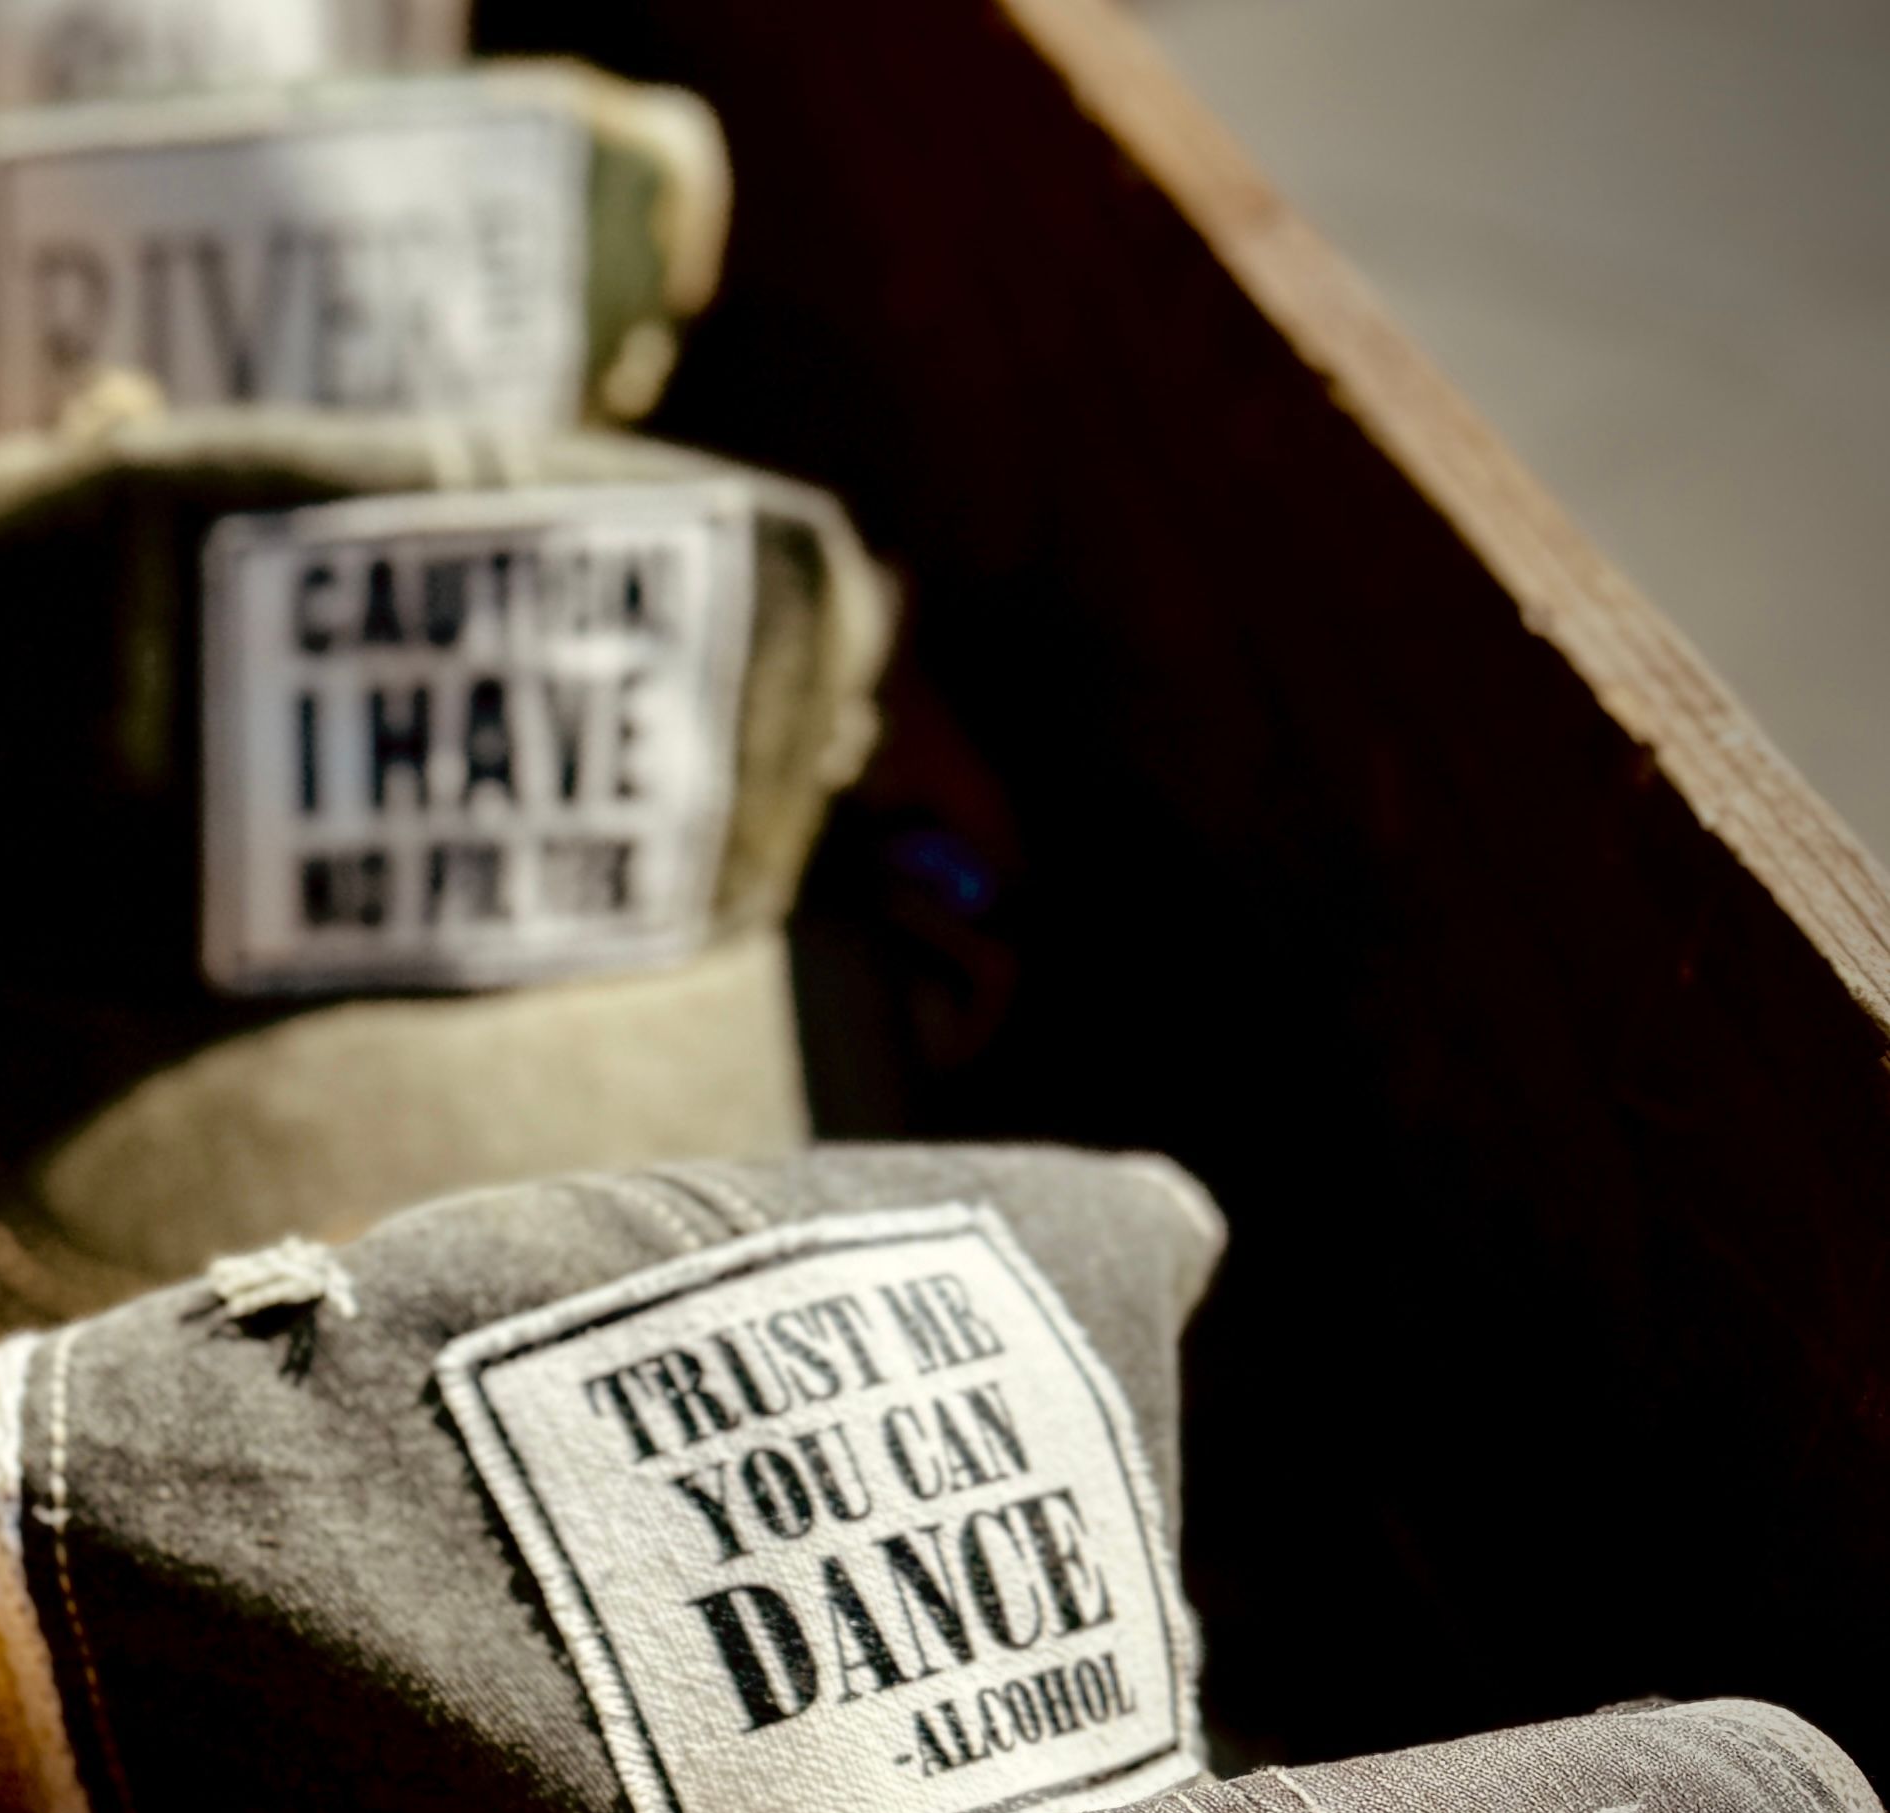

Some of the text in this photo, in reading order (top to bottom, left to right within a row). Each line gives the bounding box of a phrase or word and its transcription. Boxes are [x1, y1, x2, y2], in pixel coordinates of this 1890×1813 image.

[300, 675, 640, 812] I HAVE
[583, 1271, 1006, 1463] TRUST ME
[672, 1381, 1031, 1564] YOU CAN
[691, 1488, 1116, 1733] DANCE
